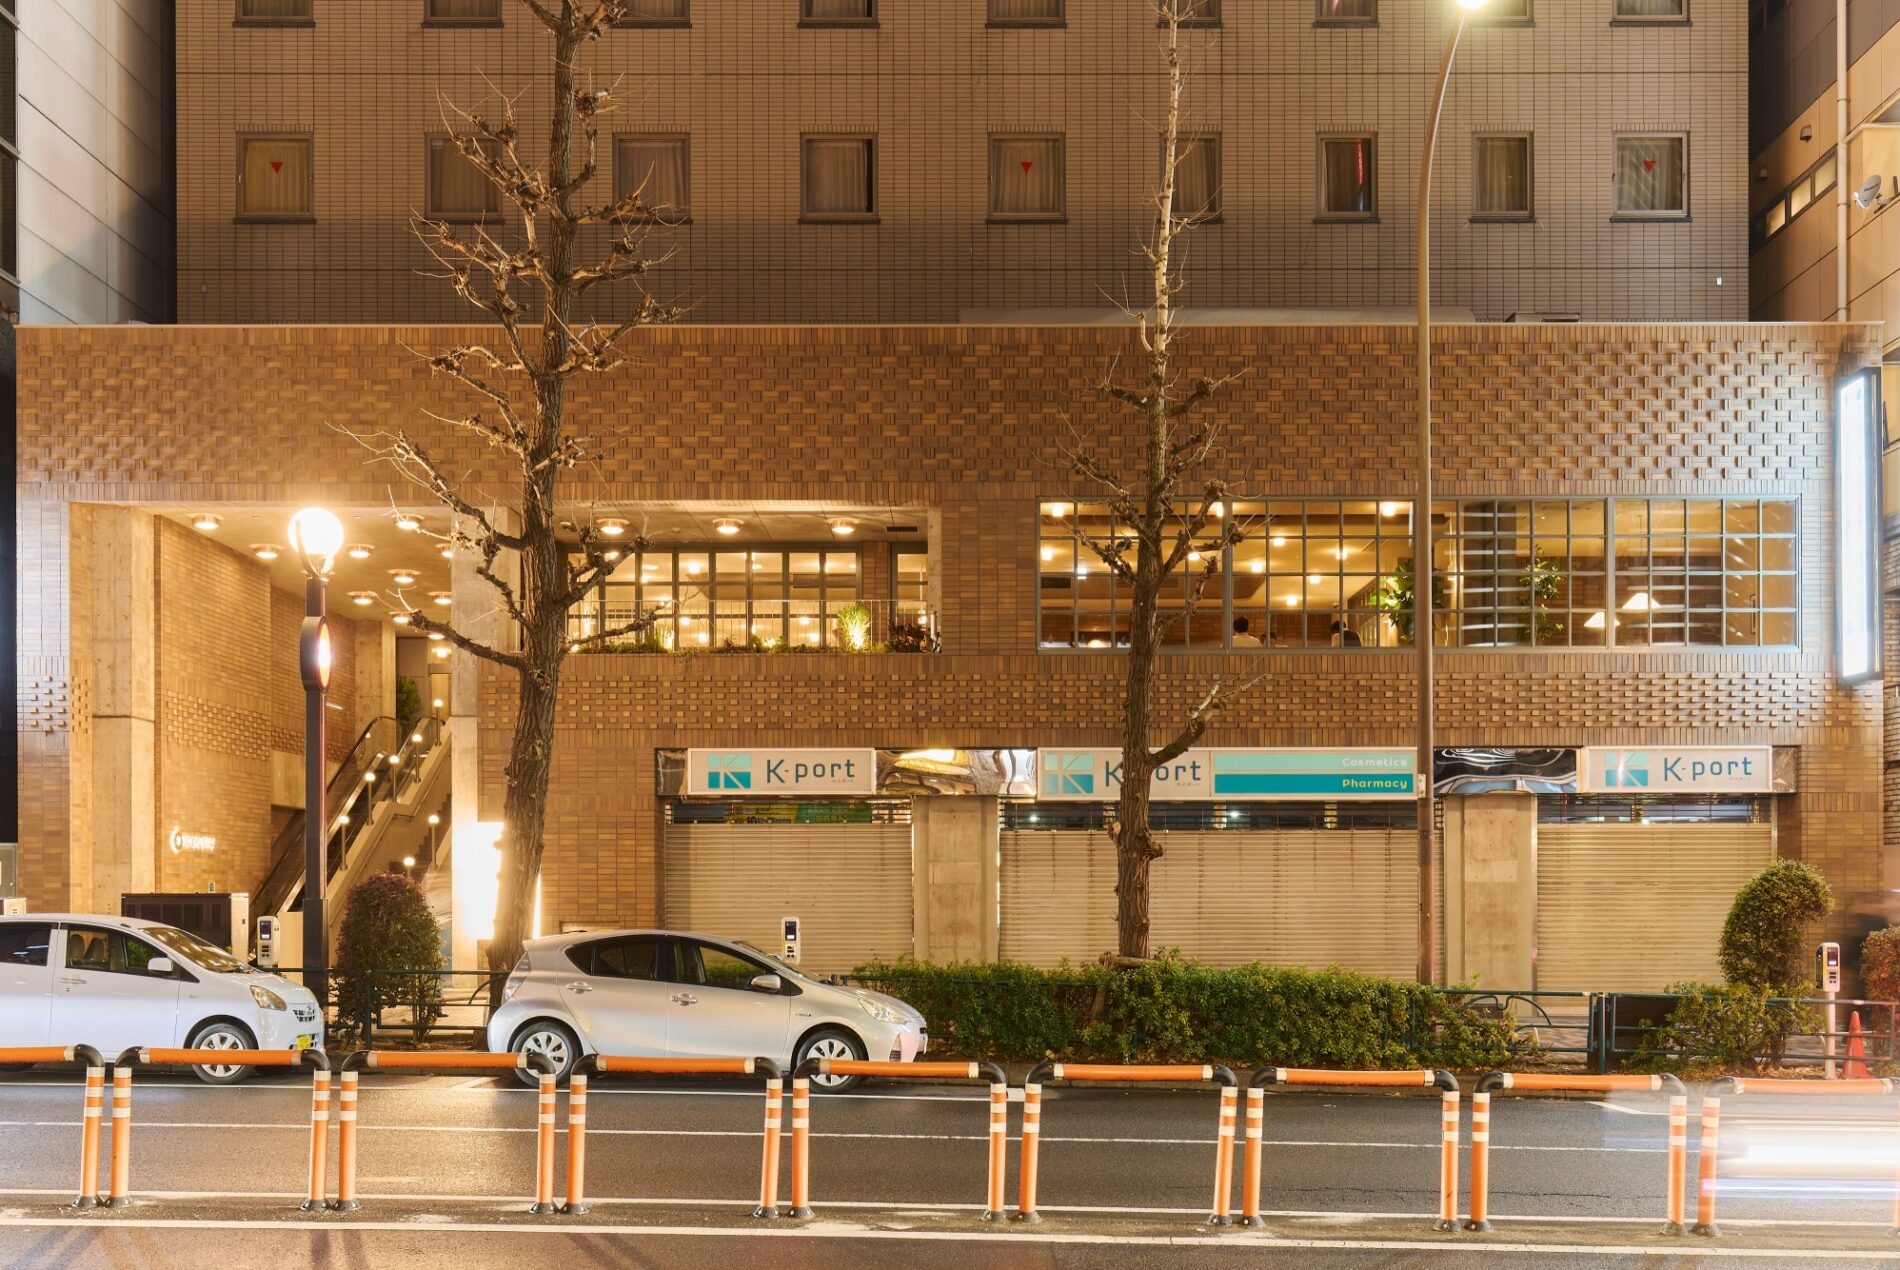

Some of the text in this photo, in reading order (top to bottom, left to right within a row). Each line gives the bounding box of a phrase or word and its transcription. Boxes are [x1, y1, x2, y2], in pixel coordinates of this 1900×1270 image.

[766, 758, 855, 784] K-port
[1105, 760, 1201, 787] Kort
[1342, 757, 1408, 767] Cosmetics
[1663, 756, 1753, 782] K-port
[1342, 778, 1408, 790] Pharmacy
